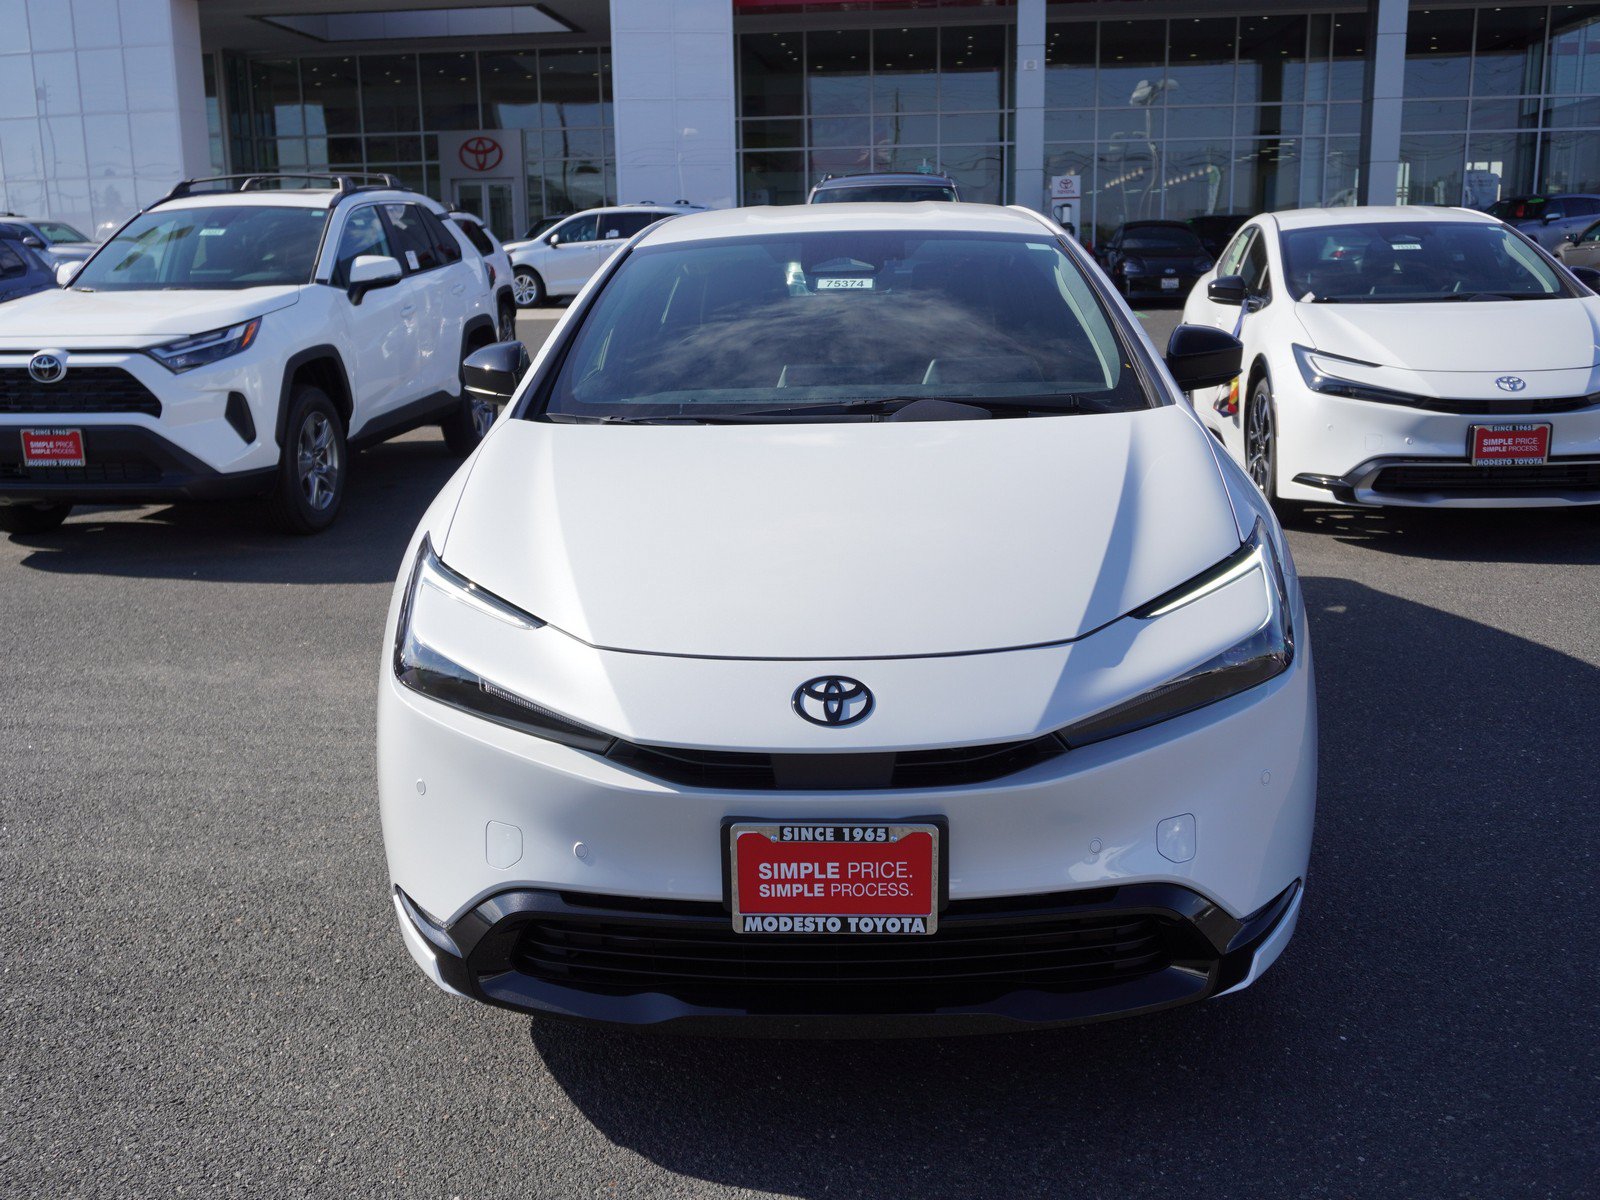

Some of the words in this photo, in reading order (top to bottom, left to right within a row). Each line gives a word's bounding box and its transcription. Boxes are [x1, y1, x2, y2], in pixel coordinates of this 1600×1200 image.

[826, 280, 864, 288] 75374
[1483, 438, 1513, 446] SIMPLE
[1515, 437, 1540, 445] PRICE.
[782, 827, 835, 841] SINCE
[843, 827, 887, 842] 1965
[758, 862, 840, 880] SIMPLE
[847, 861, 913, 879] PRICE.
[759, 883, 825, 898] SIMPLE
[830, 882, 914, 898] PROCESS.
[744, 916, 842, 933] MODESTO
[848, 917, 926, 933] TOYOTA
